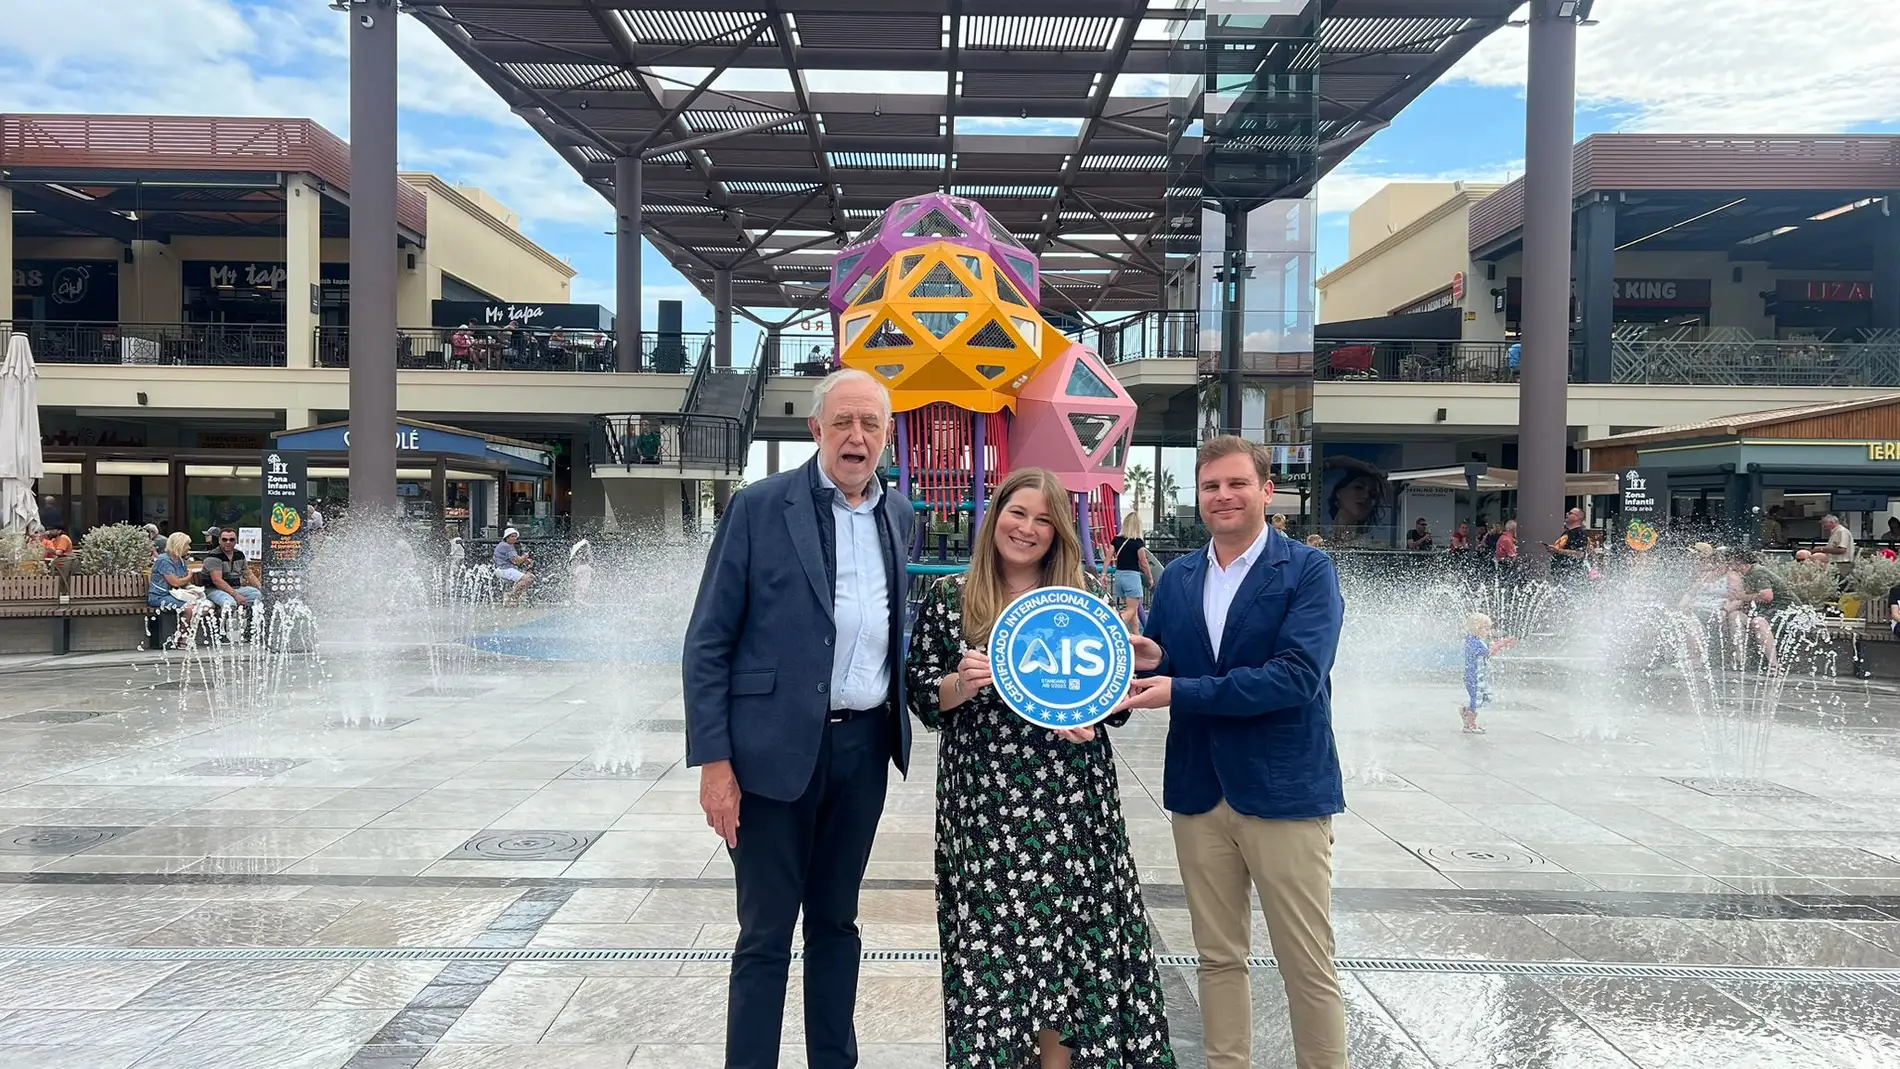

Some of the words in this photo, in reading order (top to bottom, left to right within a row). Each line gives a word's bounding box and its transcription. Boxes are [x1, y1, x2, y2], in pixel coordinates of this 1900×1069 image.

[13, 269, 43, 287] as
[210, 265, 237, 288] My
[245, 264, 287, 290] tap
[1625, 282, 1676, 299] KING
[485, 305, 503, 323] My
[508, 304, 544, 325] tapa
[1005, 593, 1090, 628] INTERNACIONAL
[1093, 606, 1110, 623] DE
[995, 629, 1025, 703] CERTIFICADO
[1018, 637, 1105, 677] AIS
[1098, 625, 1129, 707] ACCESIBILIDAD
